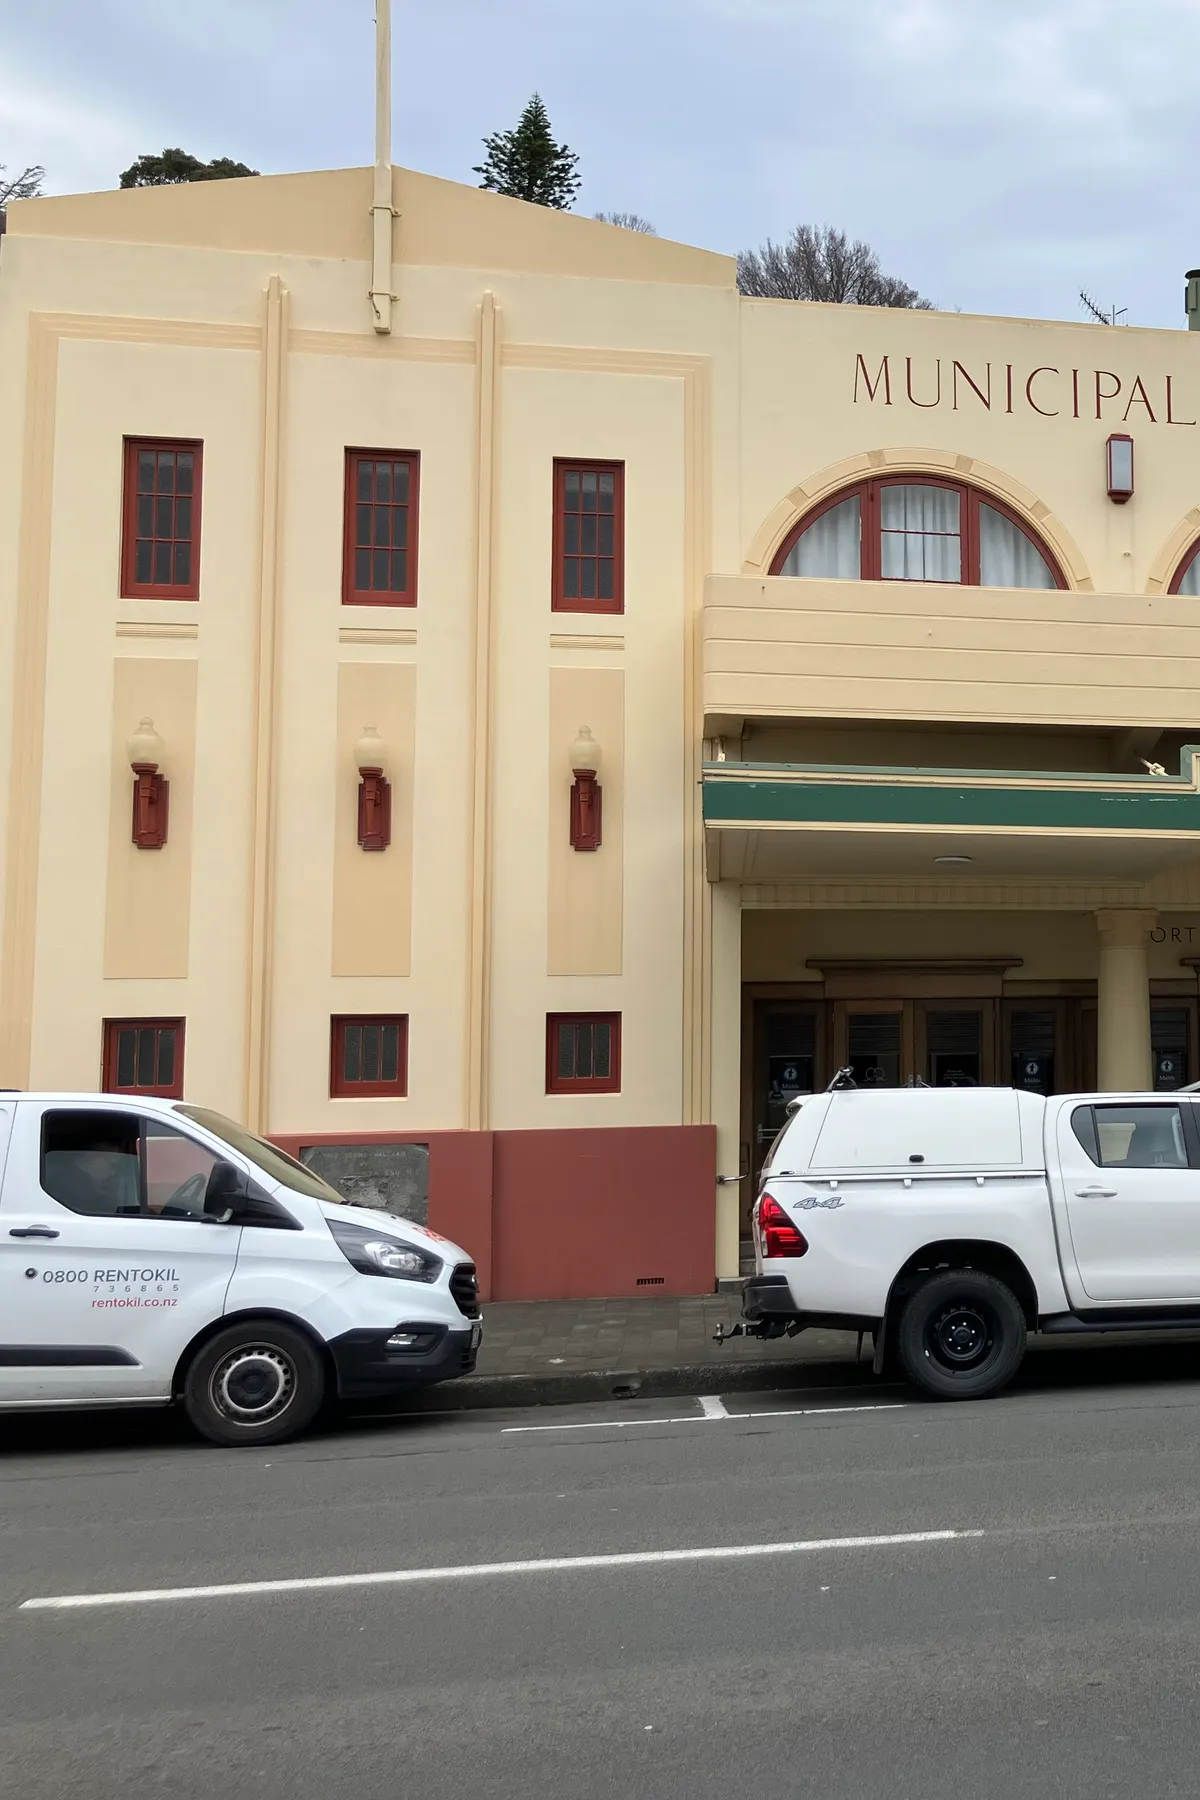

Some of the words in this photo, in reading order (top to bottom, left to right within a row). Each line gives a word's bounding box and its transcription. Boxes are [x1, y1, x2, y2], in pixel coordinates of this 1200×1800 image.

[853, 353, 1197, 426] MUNICIPAL
[1150, 926, 1197, 943] ORT
[43, 1270, 89, 1283] 0800
[93, 1269, 180, 1283] RENTOKIL
[91, 1297, 178, 1308] rentokil.co.nz
